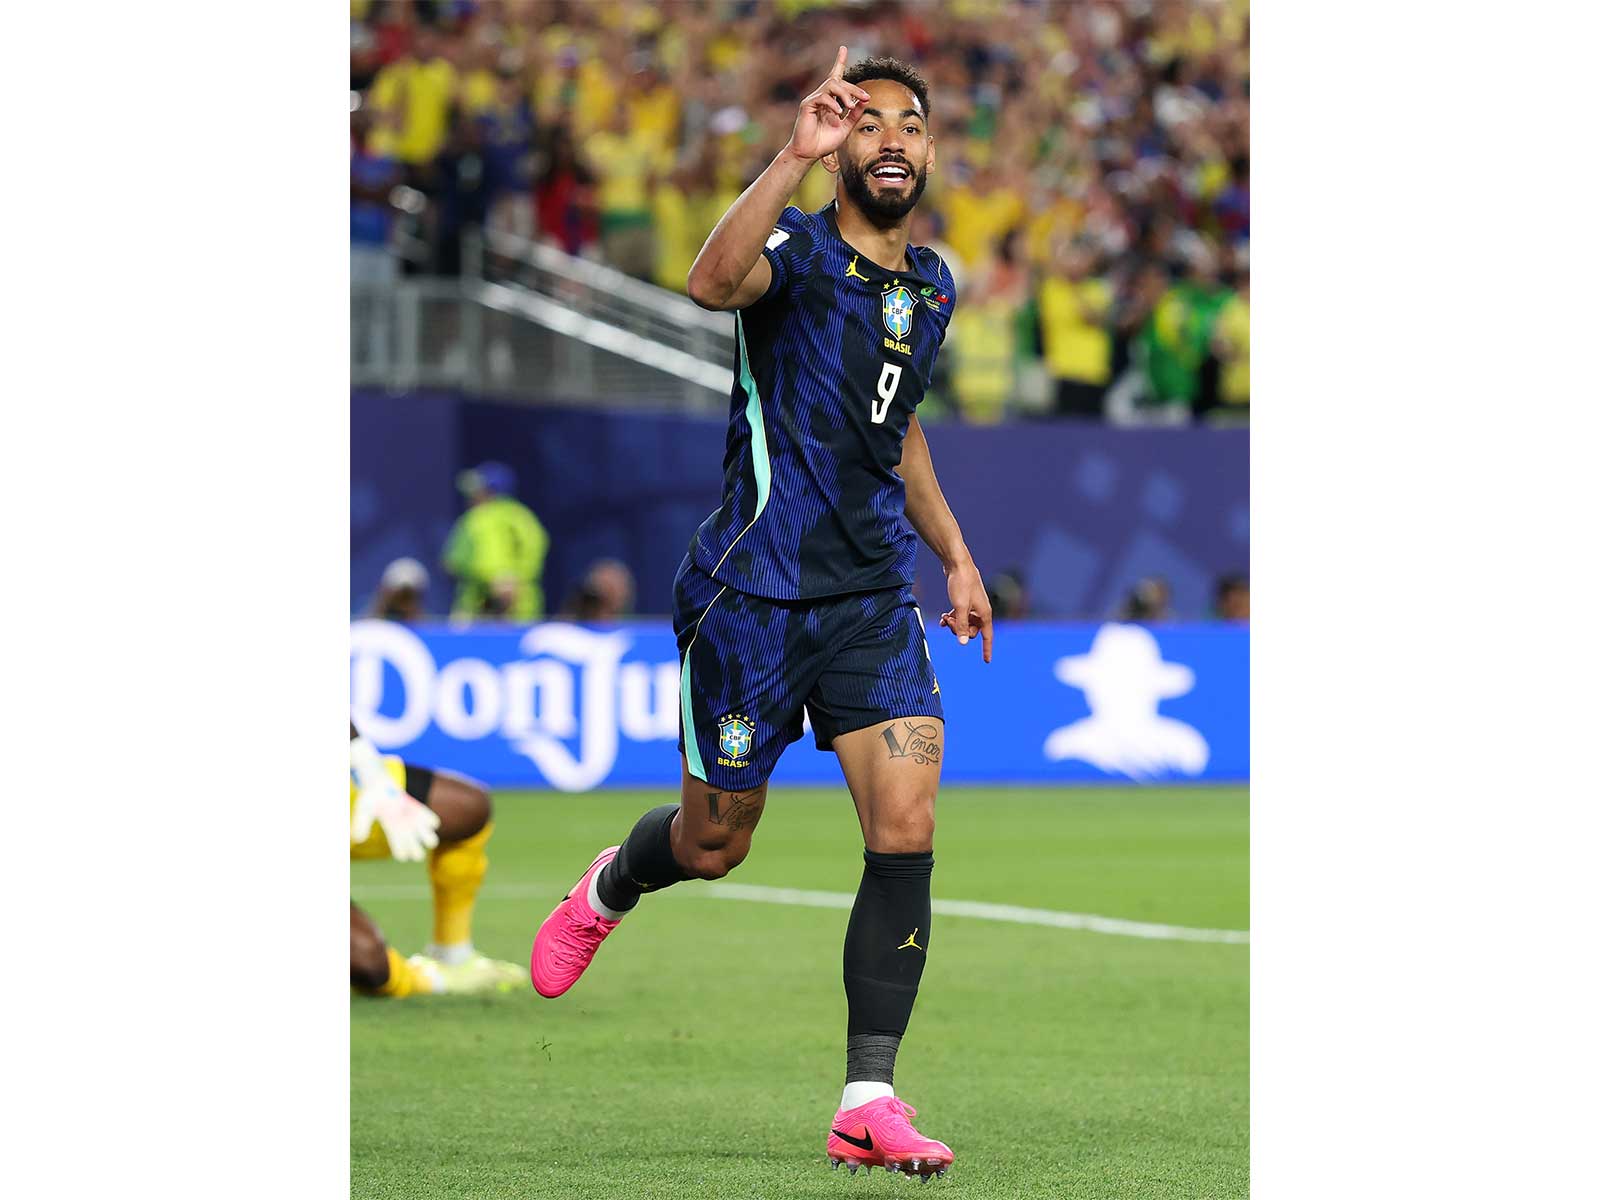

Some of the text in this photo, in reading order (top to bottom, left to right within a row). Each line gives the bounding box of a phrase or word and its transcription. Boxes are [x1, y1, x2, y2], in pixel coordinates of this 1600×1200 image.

[891, 307, 904, 315] CBF
[884, 337, 912, 356] BRASIL
[871, 362, 902, 424] 9
[717, 756, 751, 768] BRASIL
